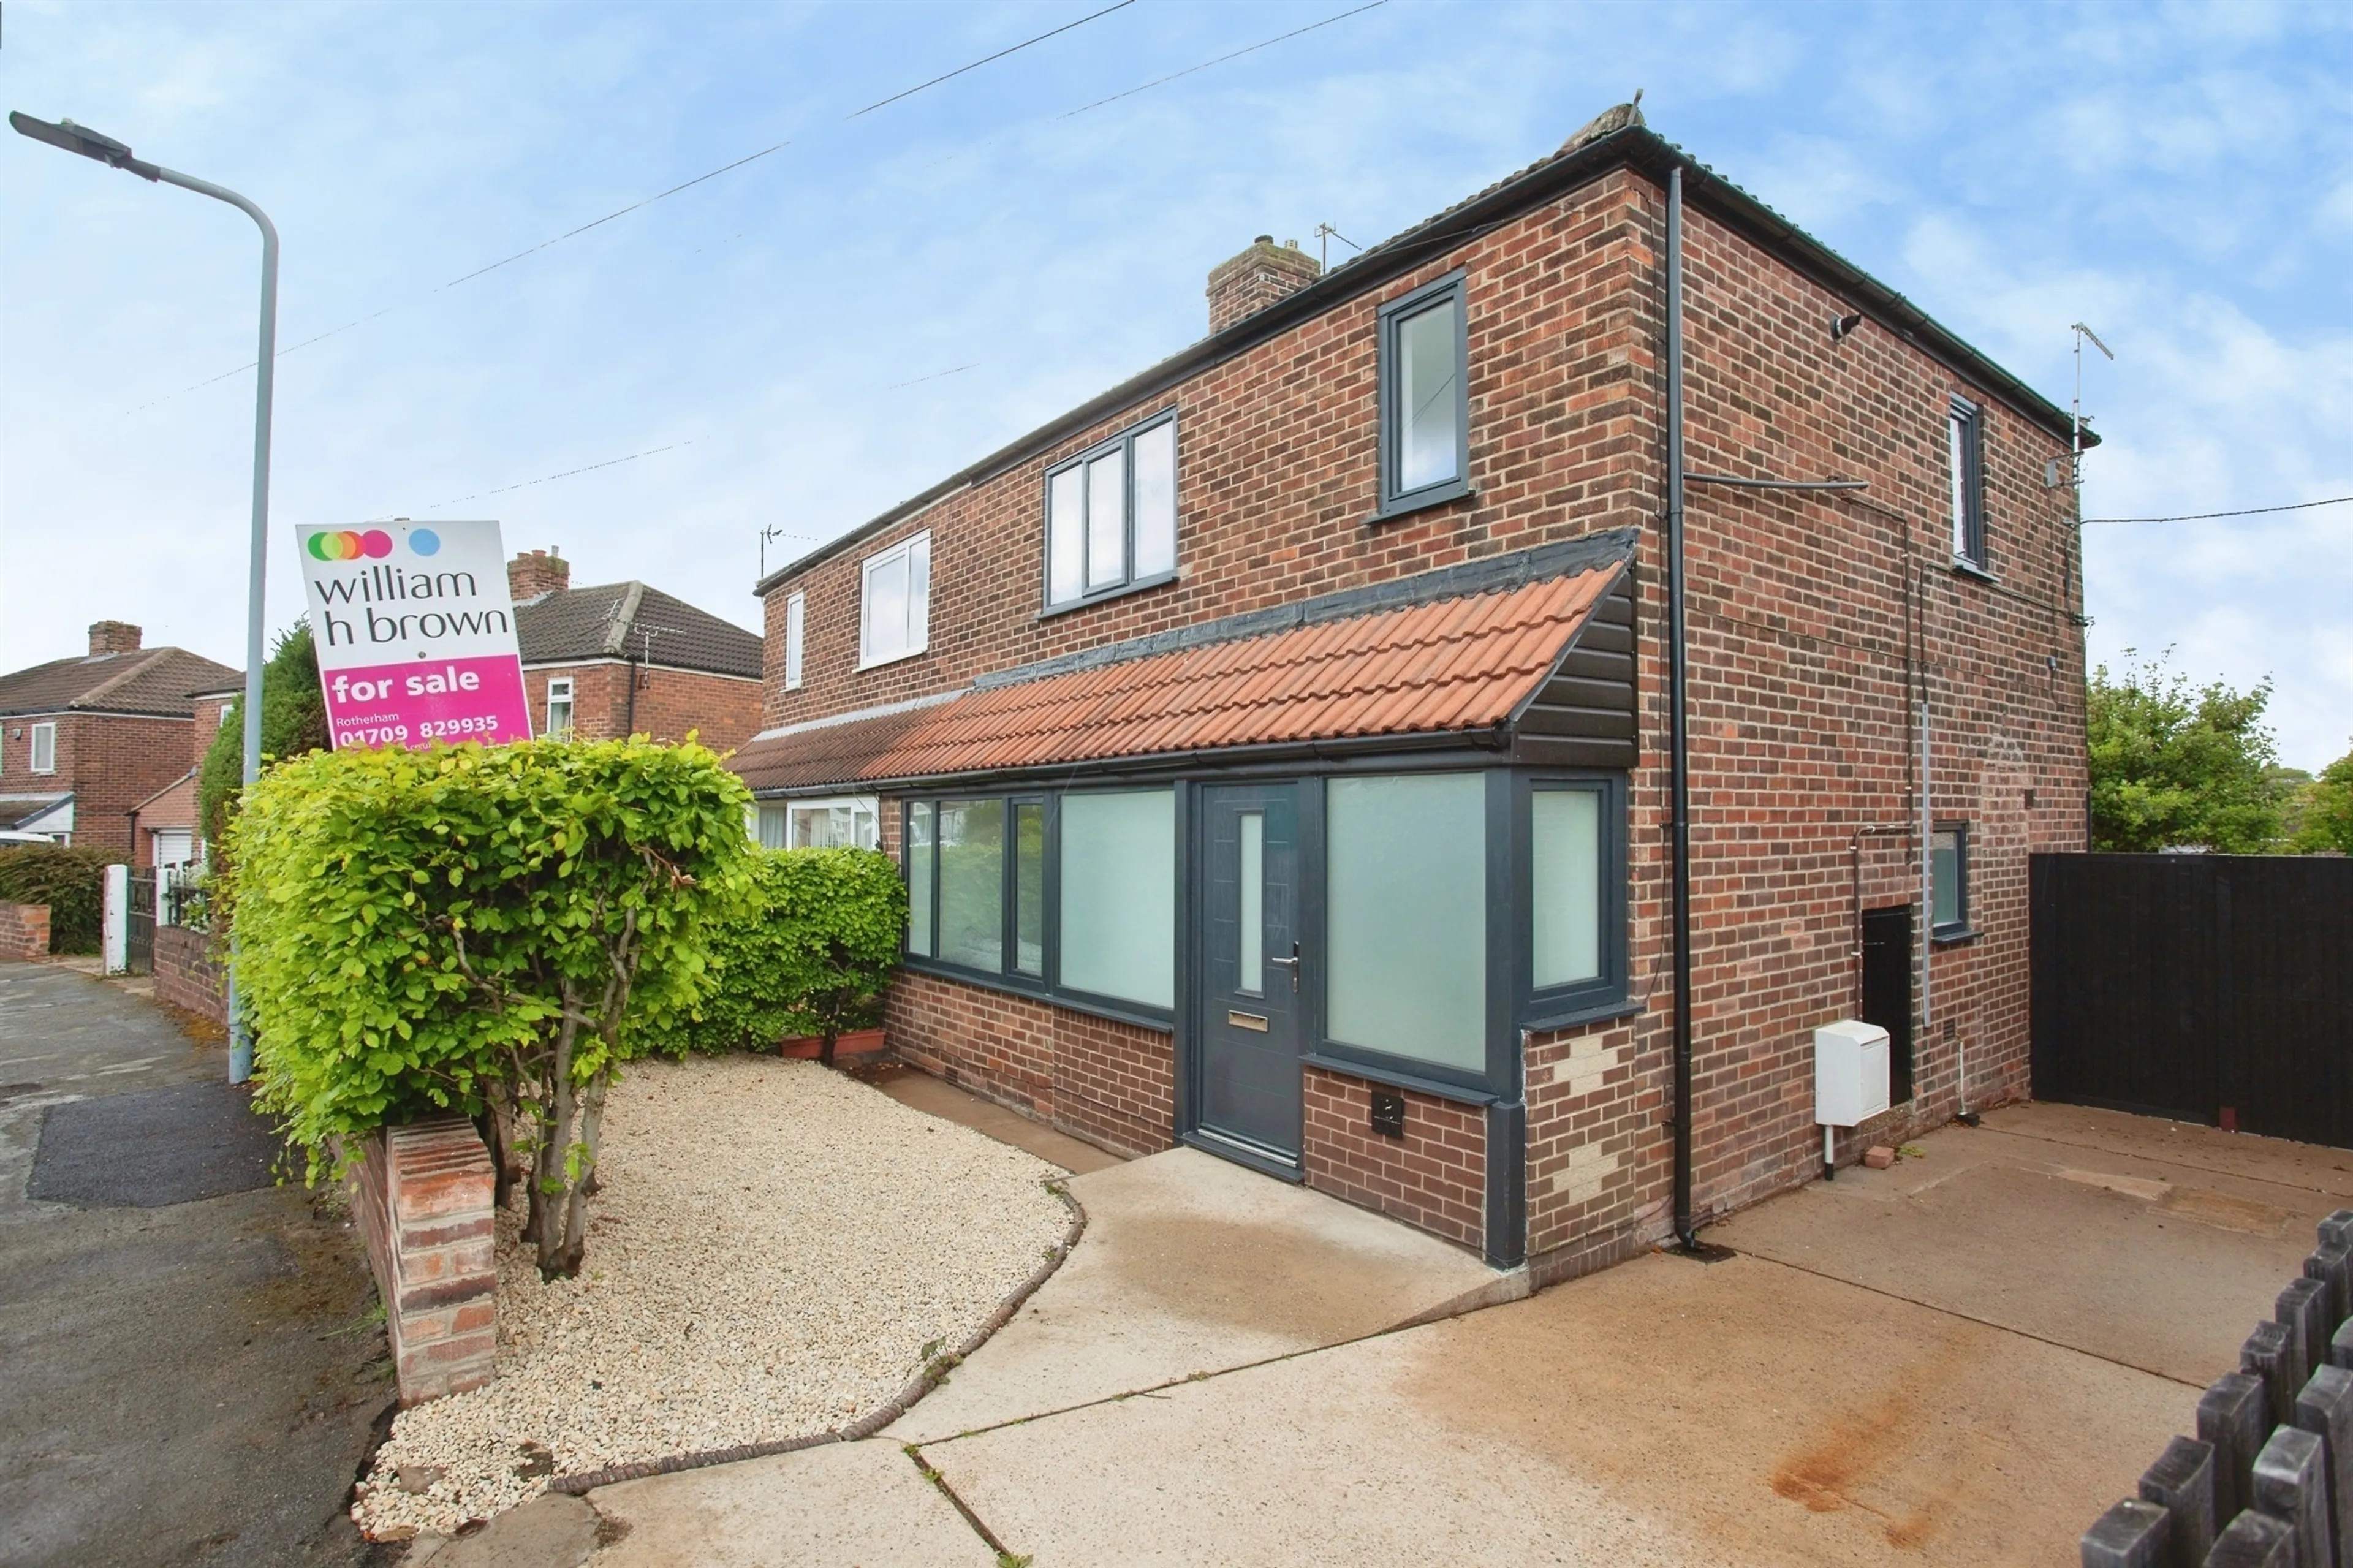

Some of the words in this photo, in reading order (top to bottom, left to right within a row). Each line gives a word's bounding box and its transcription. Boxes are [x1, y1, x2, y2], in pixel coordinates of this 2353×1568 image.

[314, 565, 477, 605] william
[325, 610, 354, 646] h
[366, 607, 507, 643] brown
[332, 675, 393, 703] for
[405, 665, 480, 696] sale
[336, 713, 400, 727] Rotherham
[339, 725, 408, 747] 01709
[420, 715, 498, 738] 829935
